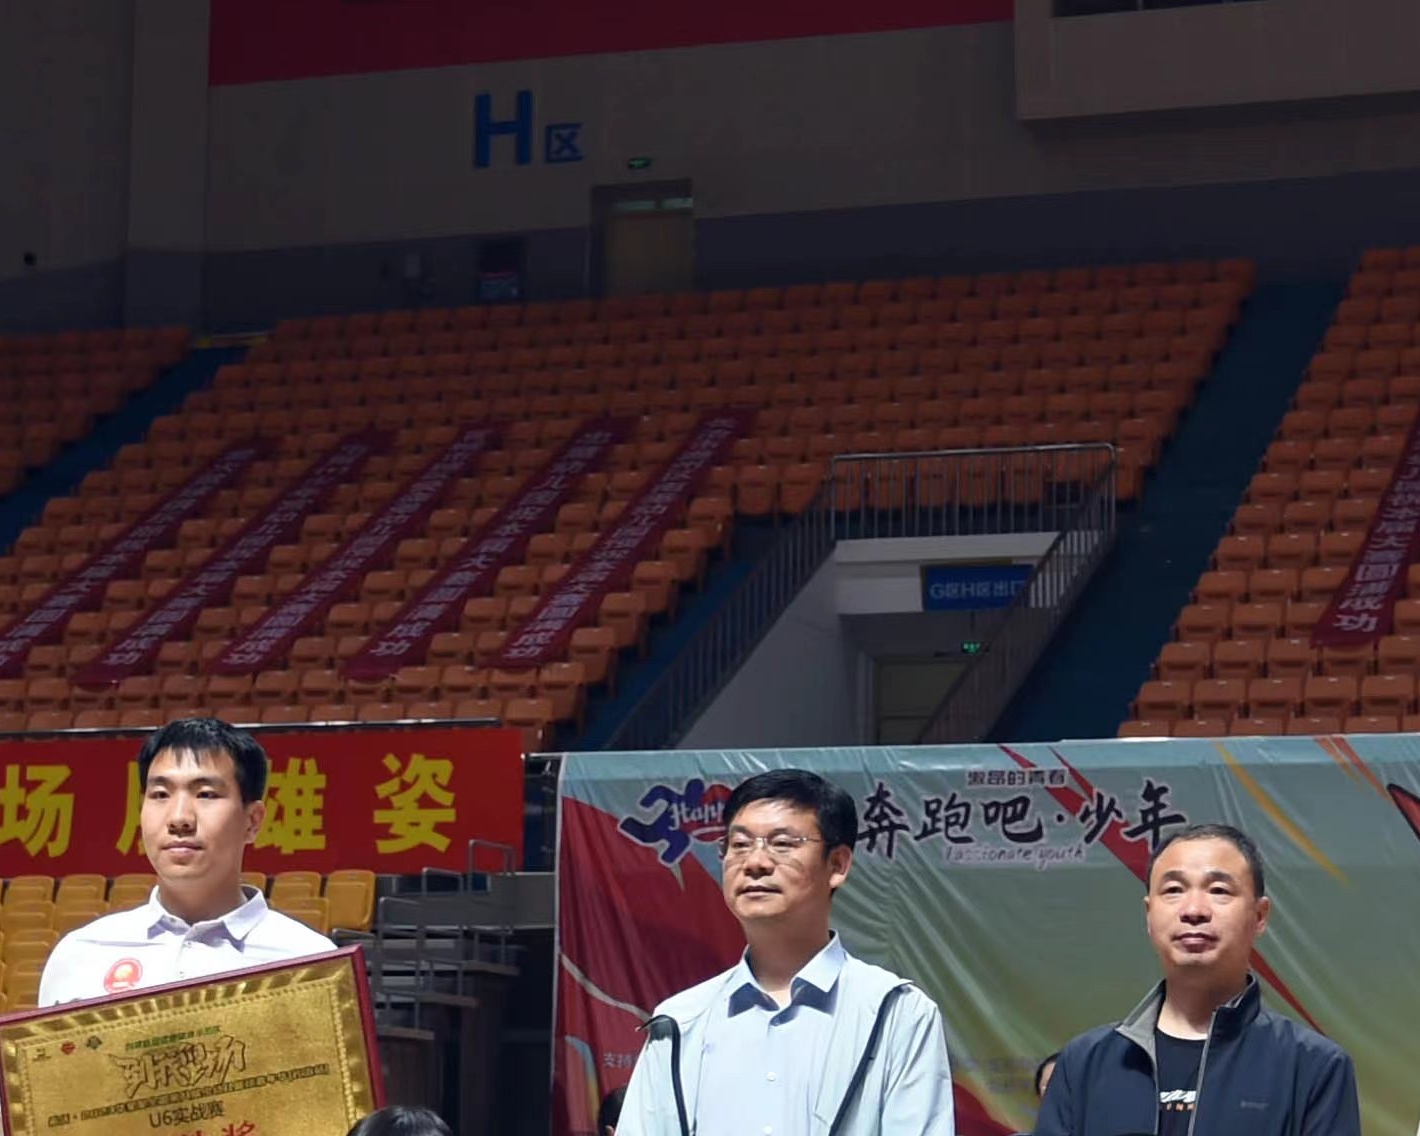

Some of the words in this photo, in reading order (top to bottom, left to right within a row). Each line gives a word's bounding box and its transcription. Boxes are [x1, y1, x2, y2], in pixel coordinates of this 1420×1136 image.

[474, 89, 584, 168] H区
[149, 1102, 225, 1129] U6实战赛
